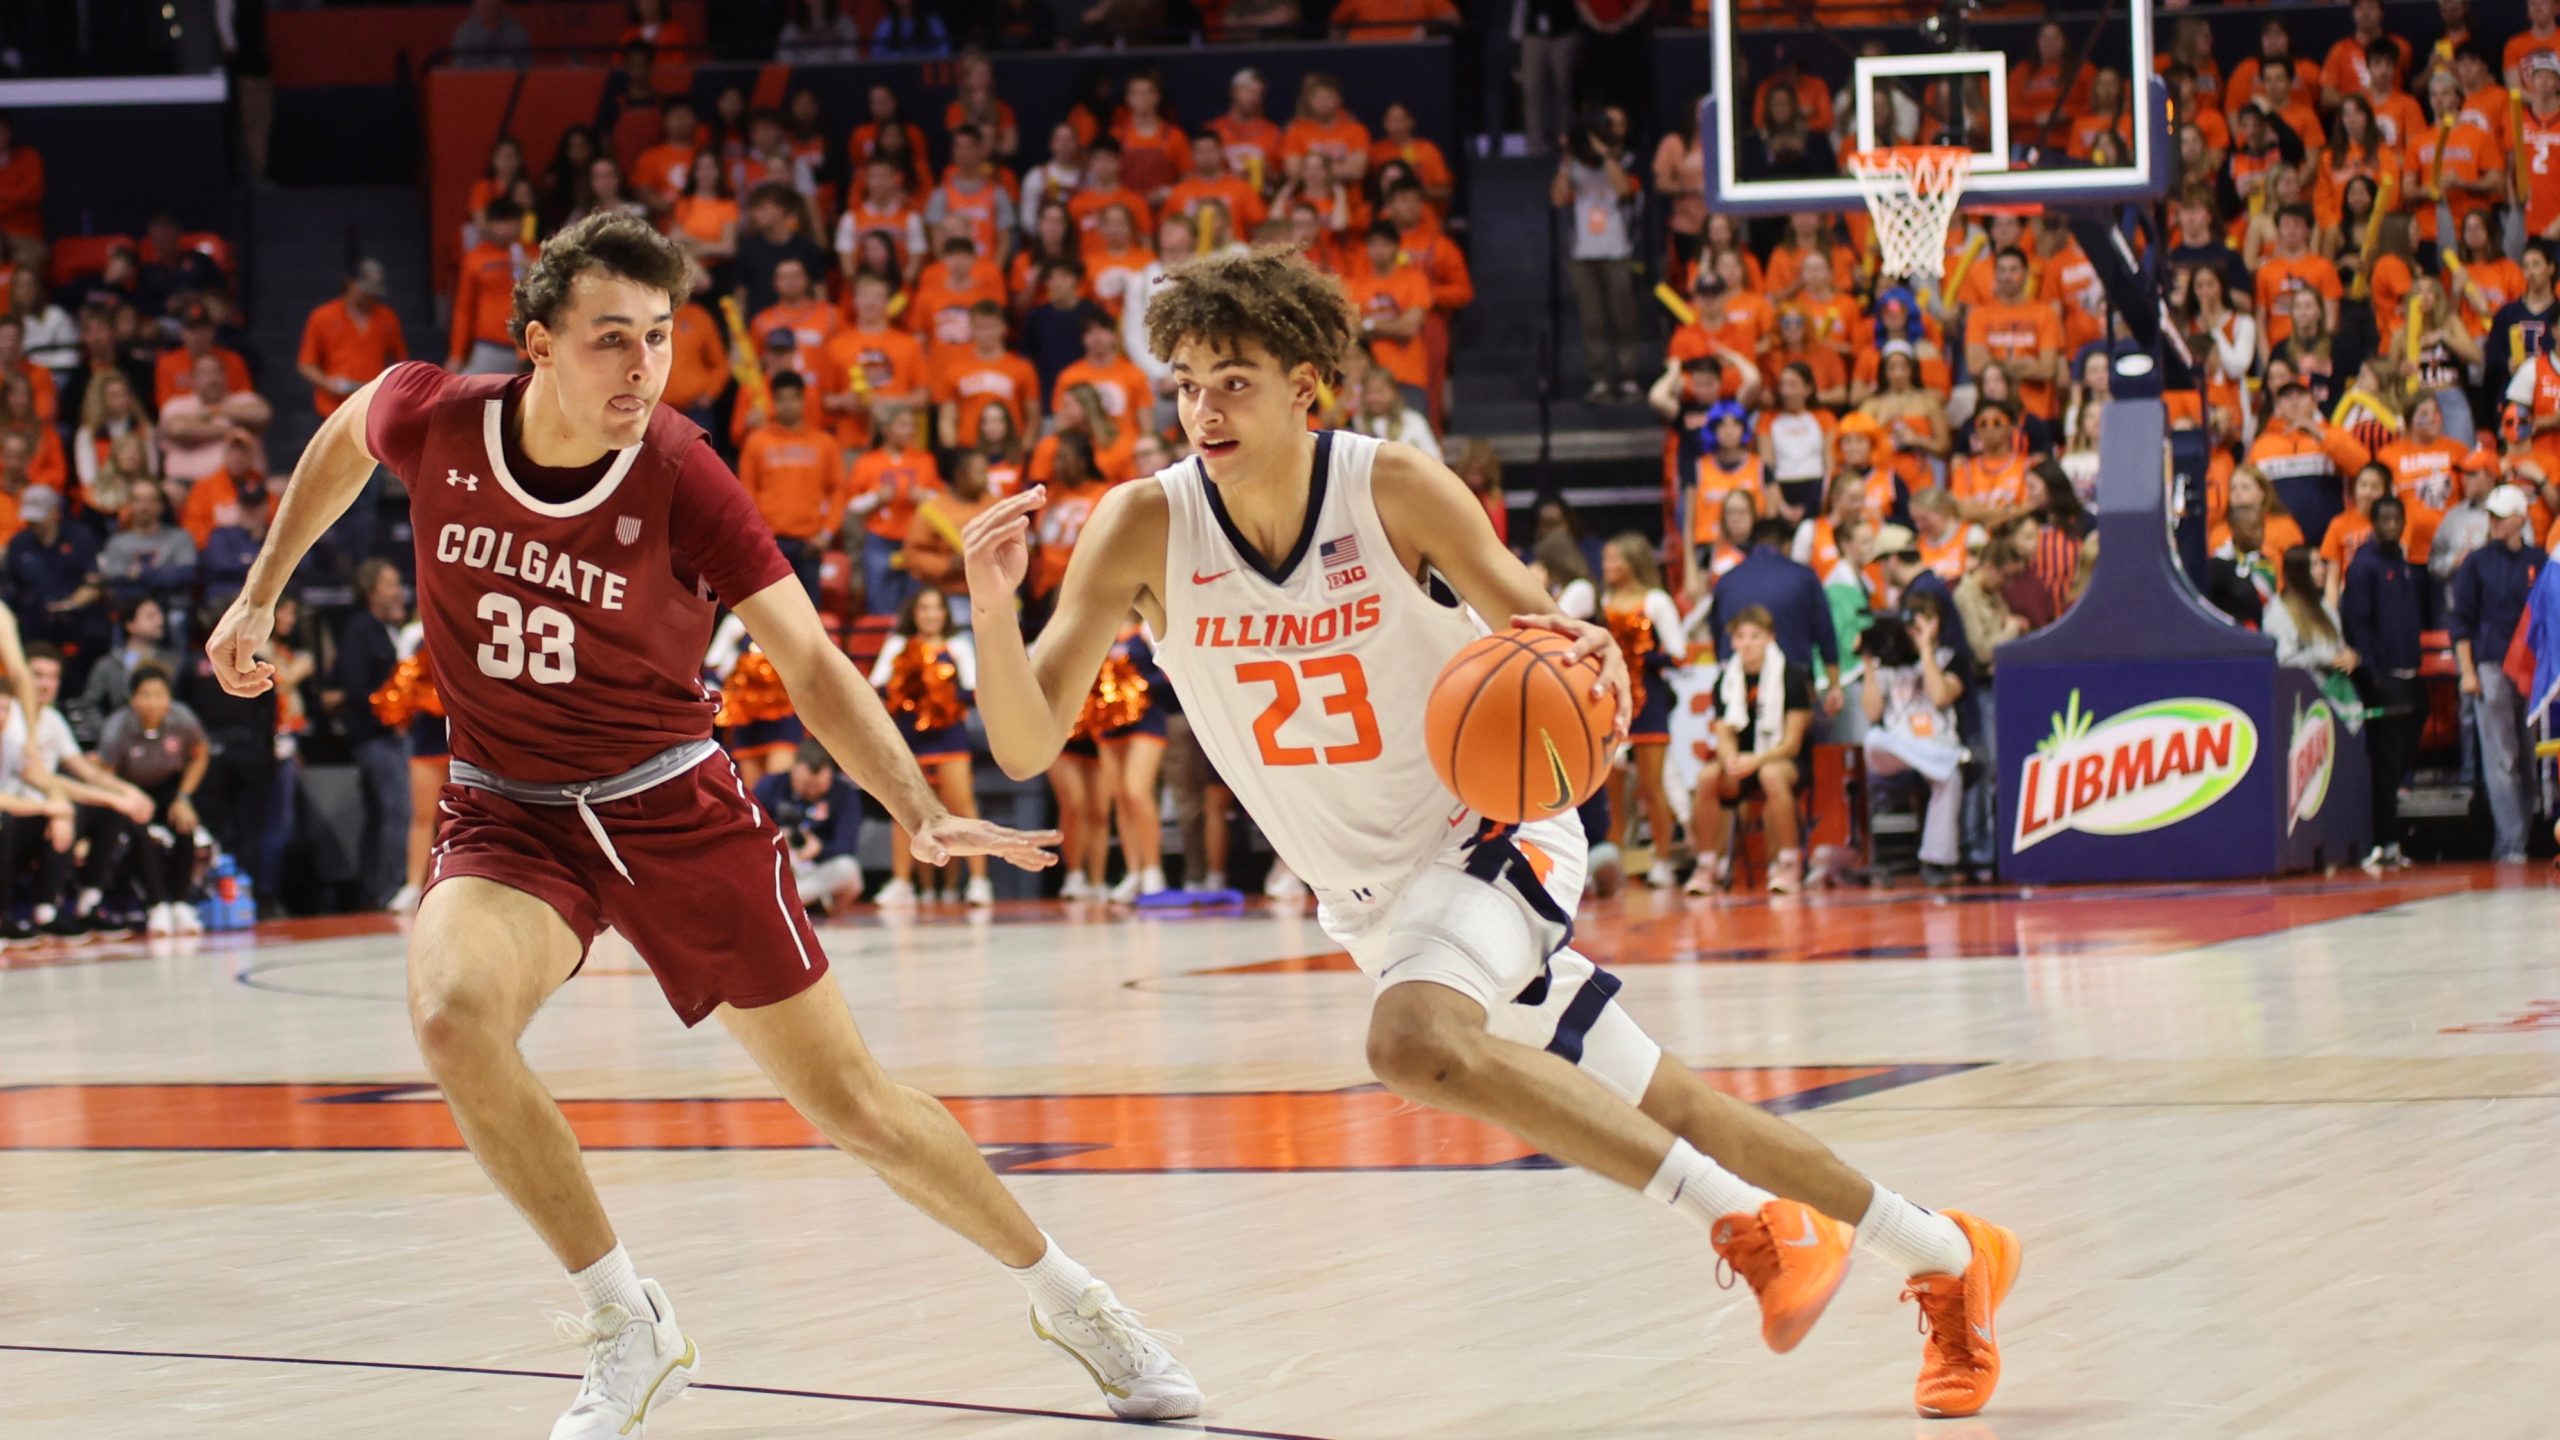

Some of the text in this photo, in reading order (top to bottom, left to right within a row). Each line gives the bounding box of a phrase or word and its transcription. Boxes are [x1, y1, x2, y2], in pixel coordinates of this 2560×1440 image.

[2532, 143, 2550, 175] 2
[437, 523, 628, 611] COLGATE
[476, 592, 577, 685] 33
[1194, 594, 1382, 648] ILLINOIS
[1234, 653, 1383, 766] 23
[2021, 721, 2234, 838] LIBMAN
